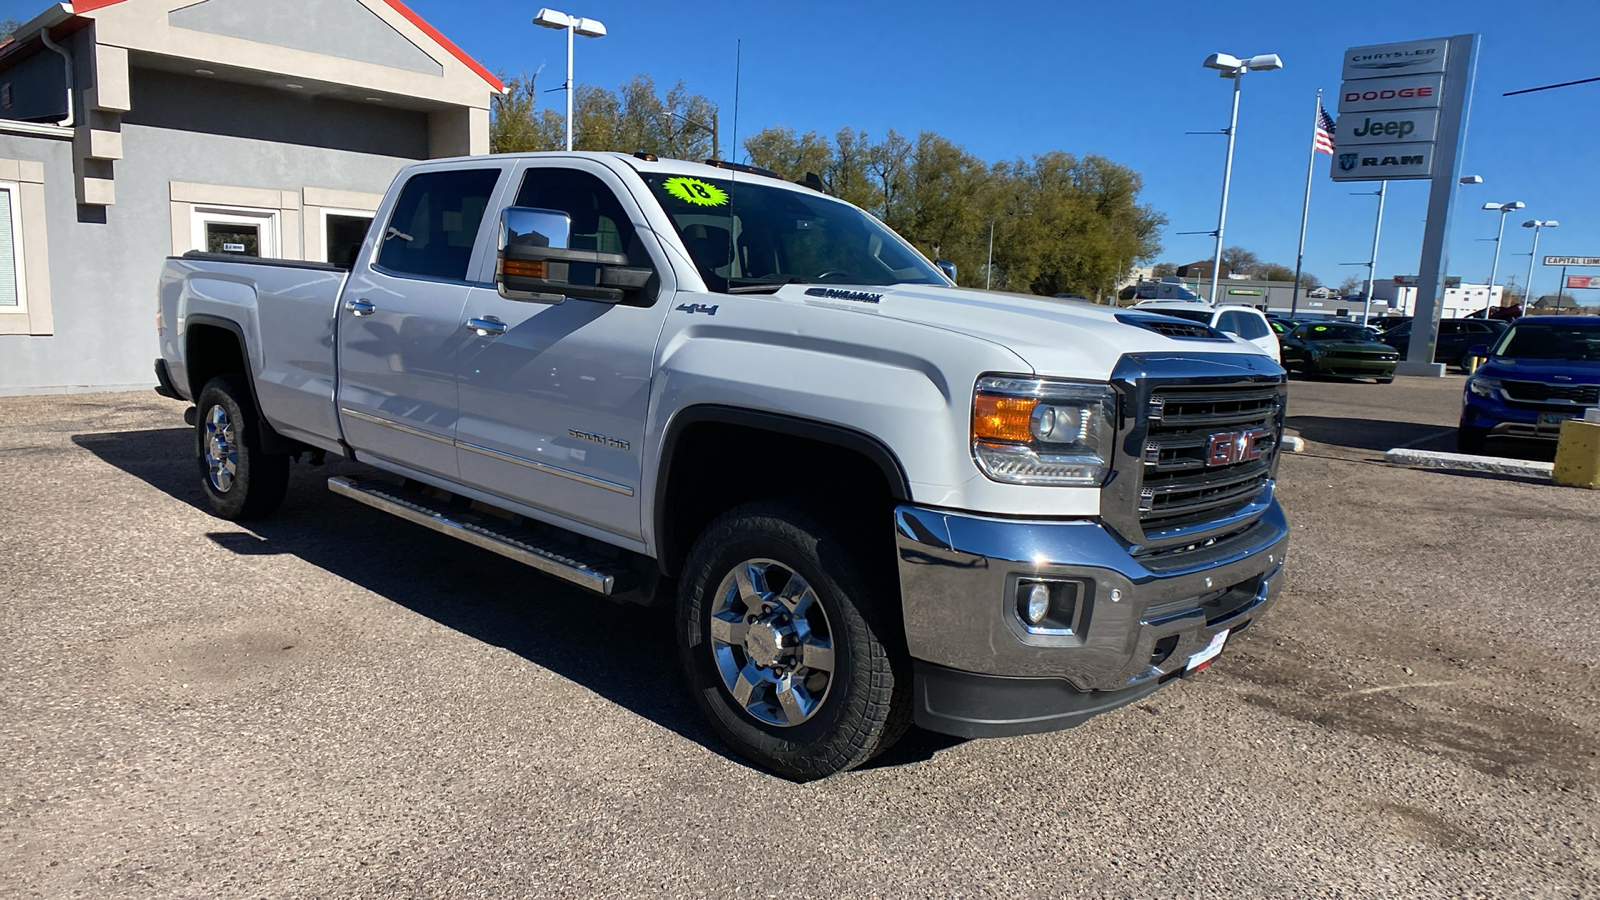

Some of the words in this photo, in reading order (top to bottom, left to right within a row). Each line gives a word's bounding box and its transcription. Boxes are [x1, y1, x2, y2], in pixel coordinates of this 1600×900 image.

[1352, 48, 1436, 62] CHRYSLER
[1345, 87, 1433, 102] DODGE
[1353, 117, 1415, 138] Jeep
[1362, 155, 1424, 167] RAM
[680, 182, 711, 199] 18
[1547, 257, 1579, 265] CAPITAL
[825, 288, 884, 304] DURAMAX
[1205, 427, 1264, 467] GMC
